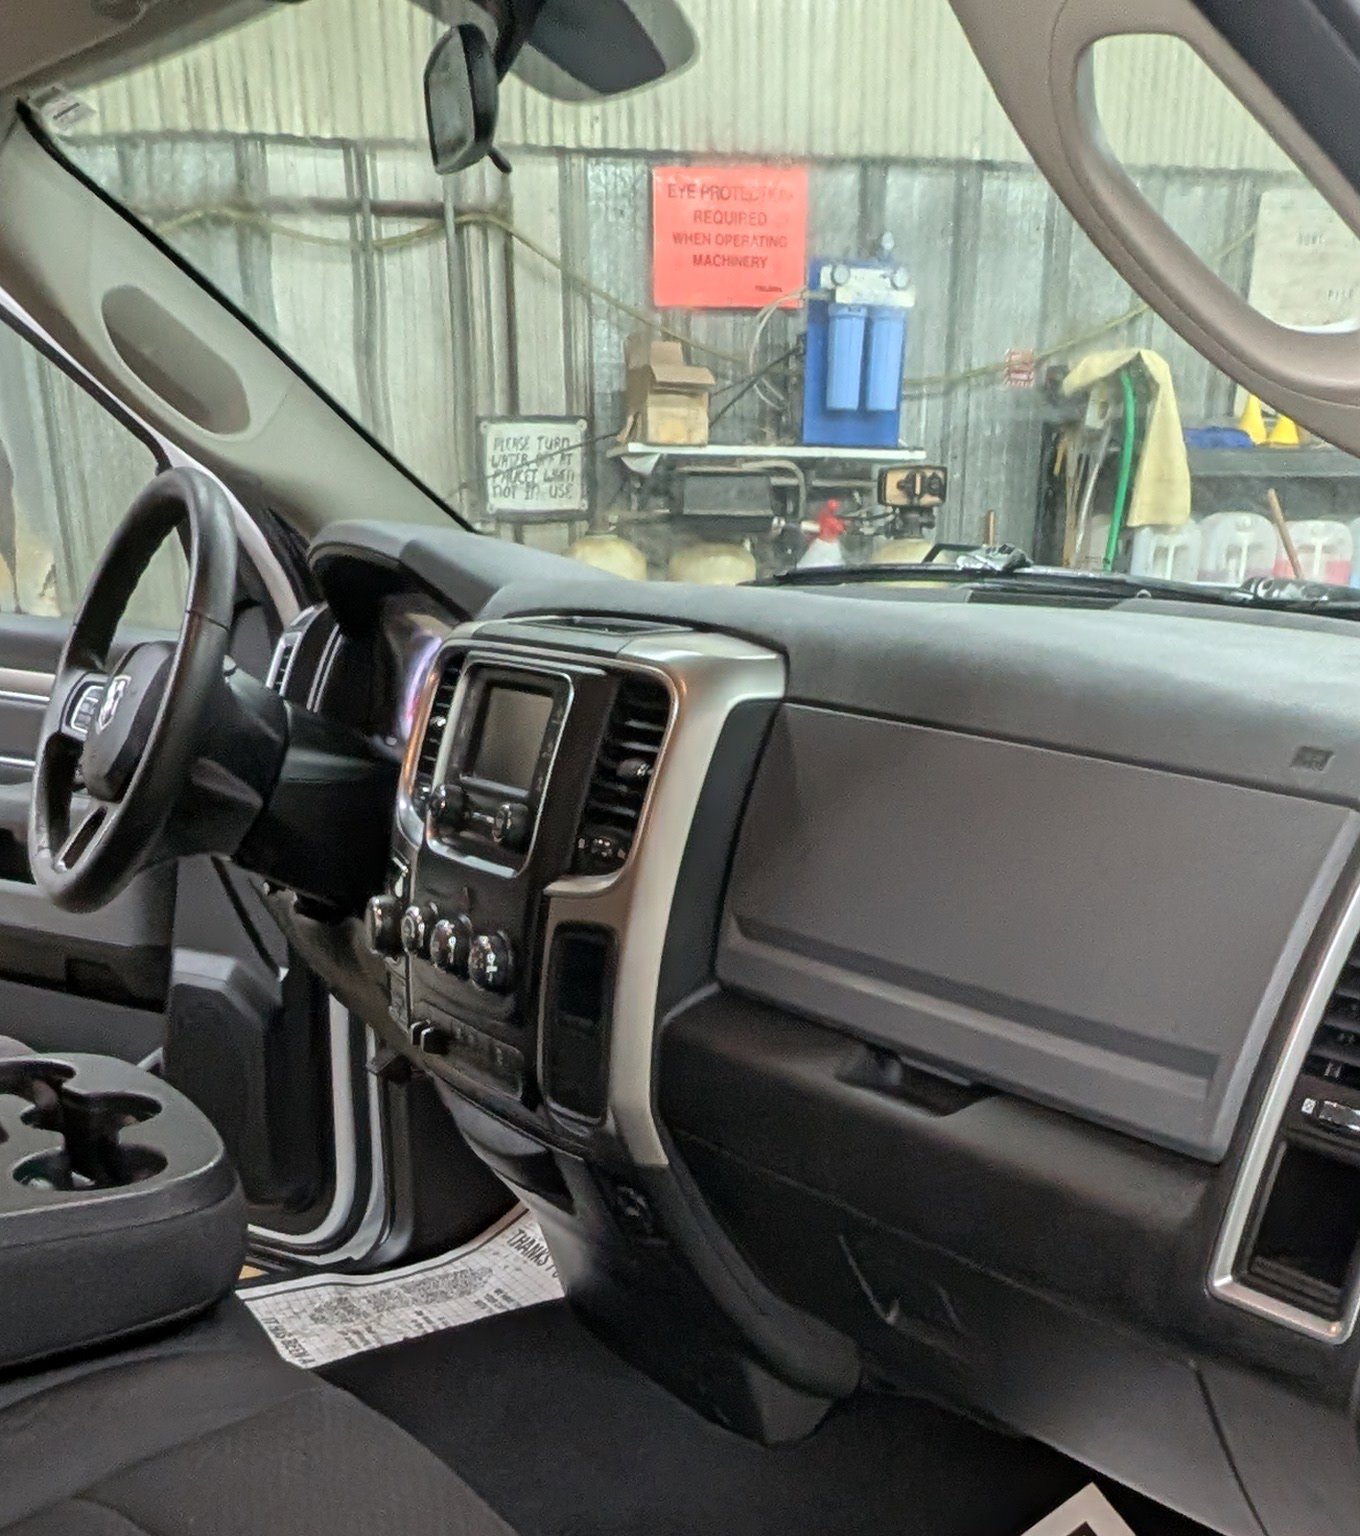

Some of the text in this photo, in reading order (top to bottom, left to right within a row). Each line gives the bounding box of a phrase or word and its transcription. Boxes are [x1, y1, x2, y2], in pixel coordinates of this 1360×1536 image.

[667, 183, 696, 199] EYE
[693, 209, 768, 226] REQUIRED
[672, 232, 788, 248] WHEN OPERATING
[692, 254, 768, 268] MACHINERY
[507, 1228, 551, 1266] THANKS
